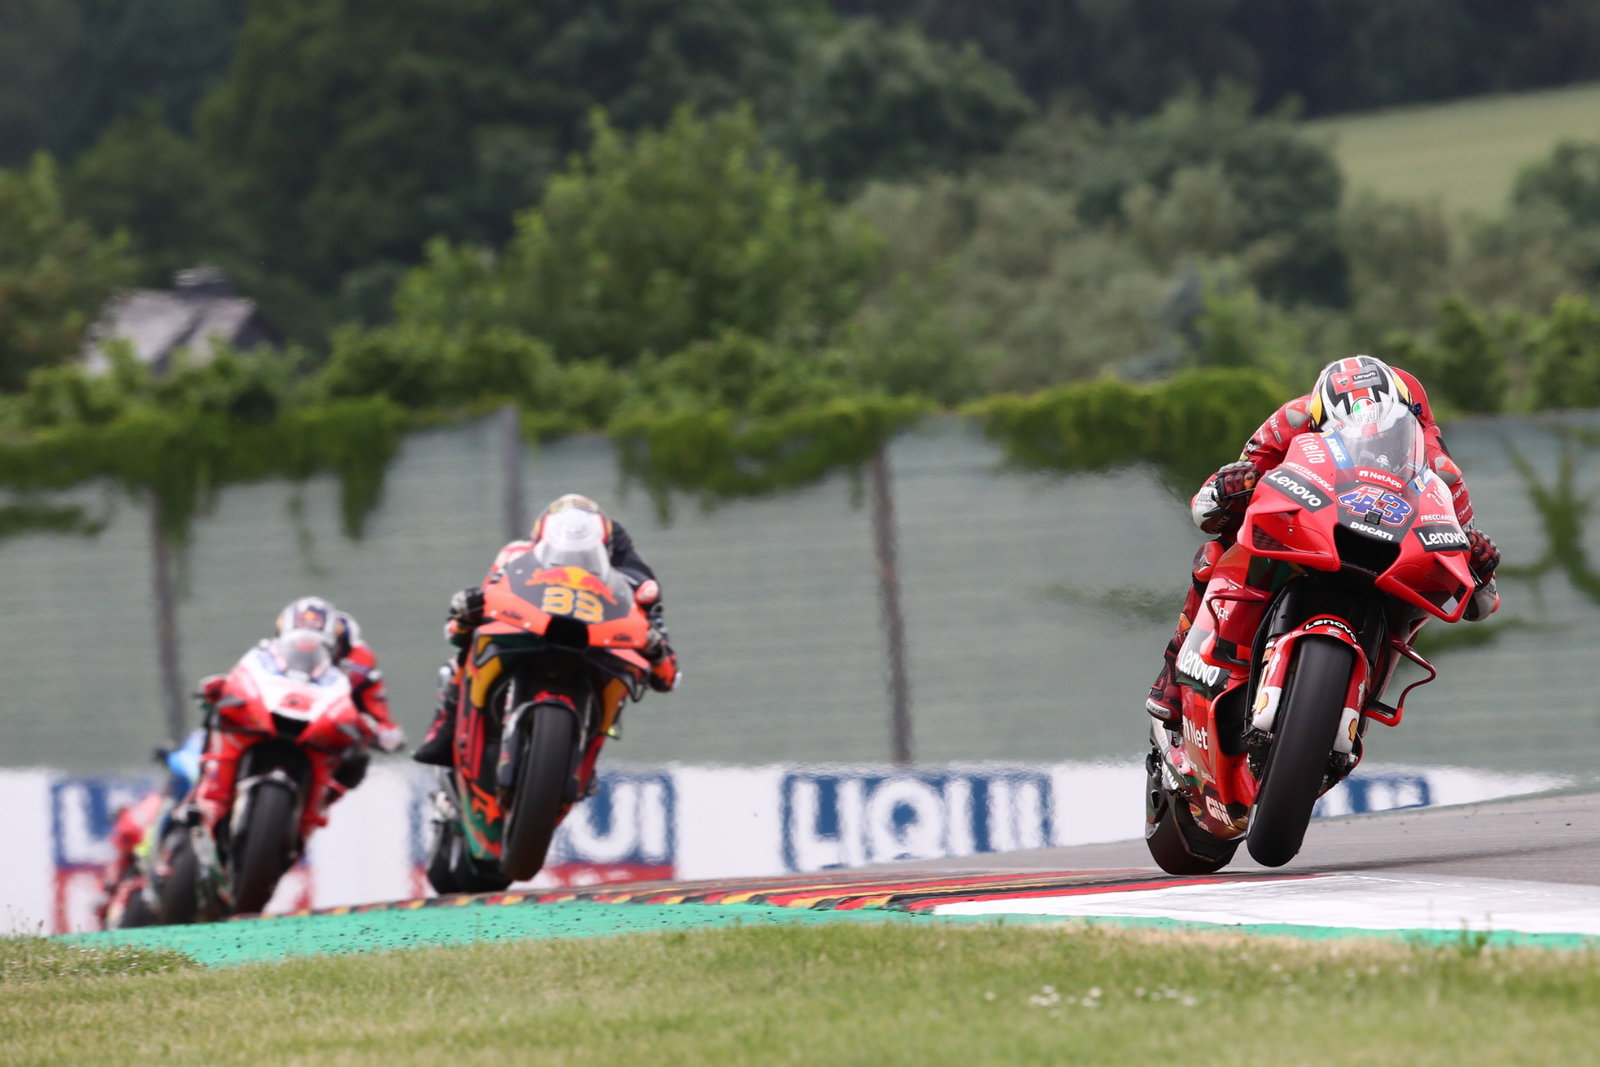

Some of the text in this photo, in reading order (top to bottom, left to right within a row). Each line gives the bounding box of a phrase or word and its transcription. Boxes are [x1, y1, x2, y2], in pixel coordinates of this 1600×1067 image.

[1267, 470, 1322, 507] Lenovo
[1369, 471, 1403, 489] NetApp
[1336, 484, 1415, 528] 43
[1349, 521, 1394, 542] DUCATI
[1418, 531, 1468, 546] Lenovo
[1304, 619, 1358, 644] Lenovo
[1178, 639, 1221, 687] Lenovo
